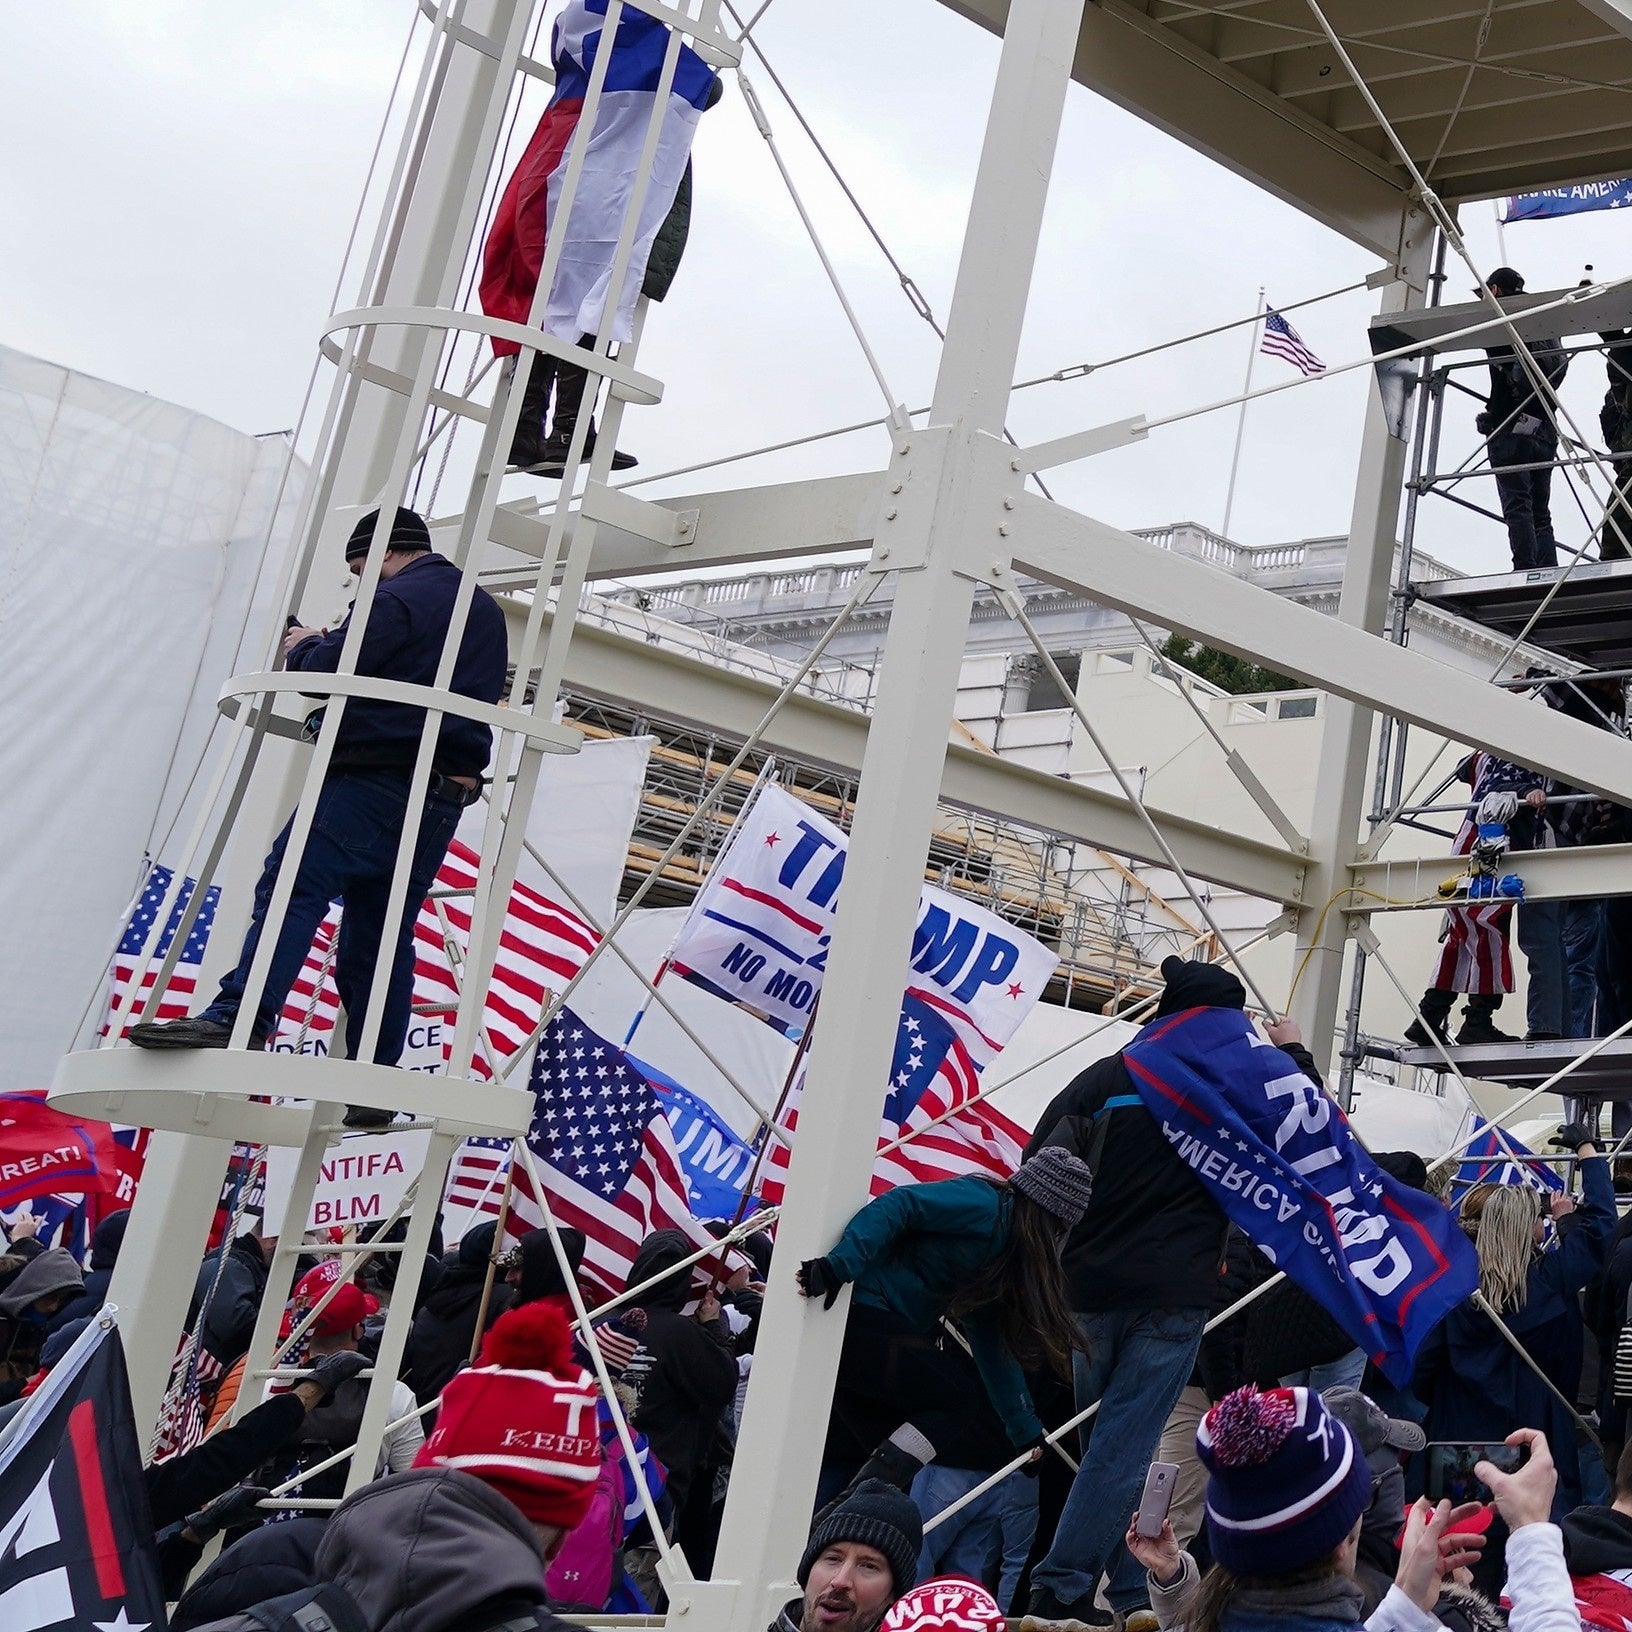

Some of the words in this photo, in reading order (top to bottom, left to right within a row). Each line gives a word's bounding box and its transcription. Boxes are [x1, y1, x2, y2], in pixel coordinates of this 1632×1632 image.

[720, 942, 767, 983] NO
[0, 1146, 82, 1184] REAT!
[317, 1152, 405, 1184] NTIFA
[314, 1194, 380, 1225] BLM
[500, 1428, 592, 1456] KEEP
